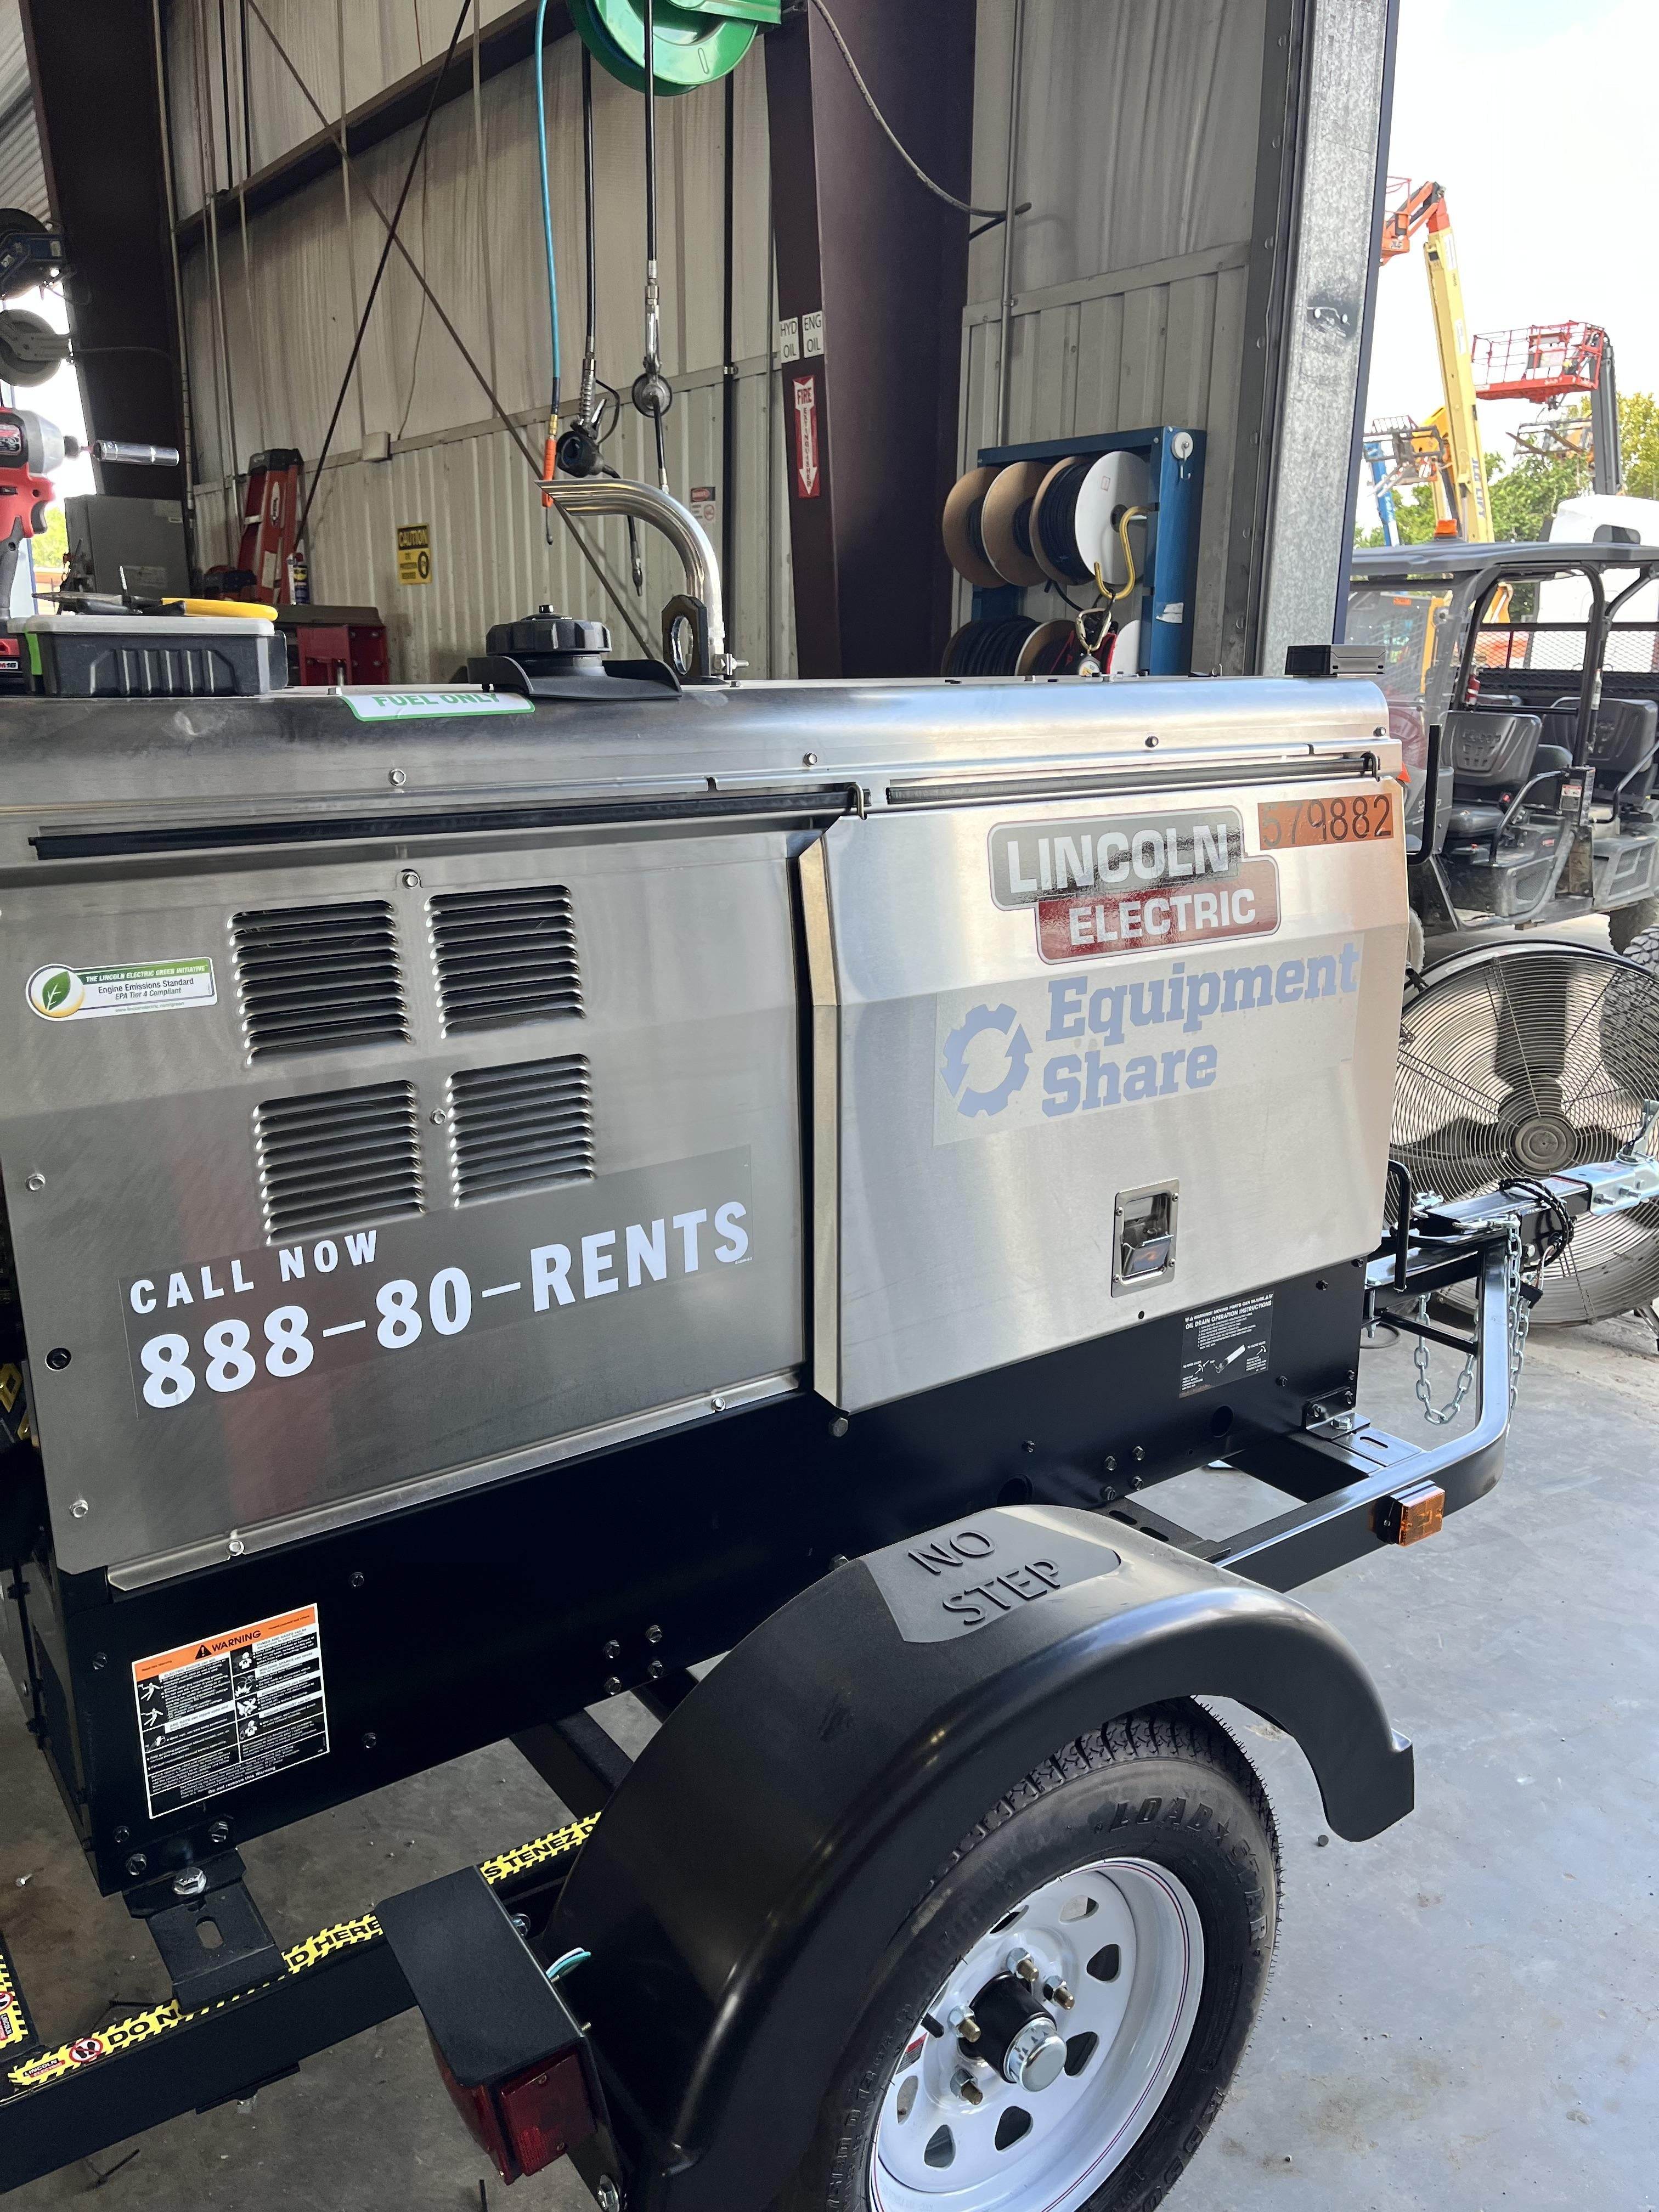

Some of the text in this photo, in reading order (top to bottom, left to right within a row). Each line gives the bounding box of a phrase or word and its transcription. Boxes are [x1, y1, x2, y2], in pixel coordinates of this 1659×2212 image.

[780, 321, 797, 337] HYD
[804, 314, 822, 331] ENG
[783, 343, 797, 358] OIL
[807, 337, 821, 352] OIL
[797, 387, 812, 405] FIRE
[399, 529, 427, 548] CAUTION
[372, 692, 500, 707] FUEL ONLY
[1262, 793, 1392, 849] 579882
[1007, 823, 1229, 894] LINCOLN
[1070, 888, 1256, 946] ELECTRIC
[98, 978, 194, 995] Engine Emissions Standard
[99, 973, 125, 981] LINCOLN
[126, 970, 154, 979] ELECTRIC
[156, 968, 175, 977] GREEN
[150, 988, 181, 997] Compliant
[1045, 941, 1360, 1047] Equipment
[1042, 1043, 1218, 1118] Share
[130, 1229, 379, 1314] CALL NOW
[1195, 1318, 1210, 1327] DRAIN
[1211, 1311, 1239, 1323] OPERATION
[1239, 1300, 1272, 1313] INSTRUCTIONS
[907, 1530, 996, 1576] NO
[942, 1558, 1060, 1626] STEP
[212, 1630, 261, 1652] WARNING
[1108, 1795, 1214, 1832] LOAD
[503, 1831, 579, 1867] TENEZ
[1227, 1838, 1268, 1946] STAR
[313, 1918, 381, 1951] HERE
[107, 2020, 149, 2045] DO
[25, 2059, 57, 2076] LINCOLN
